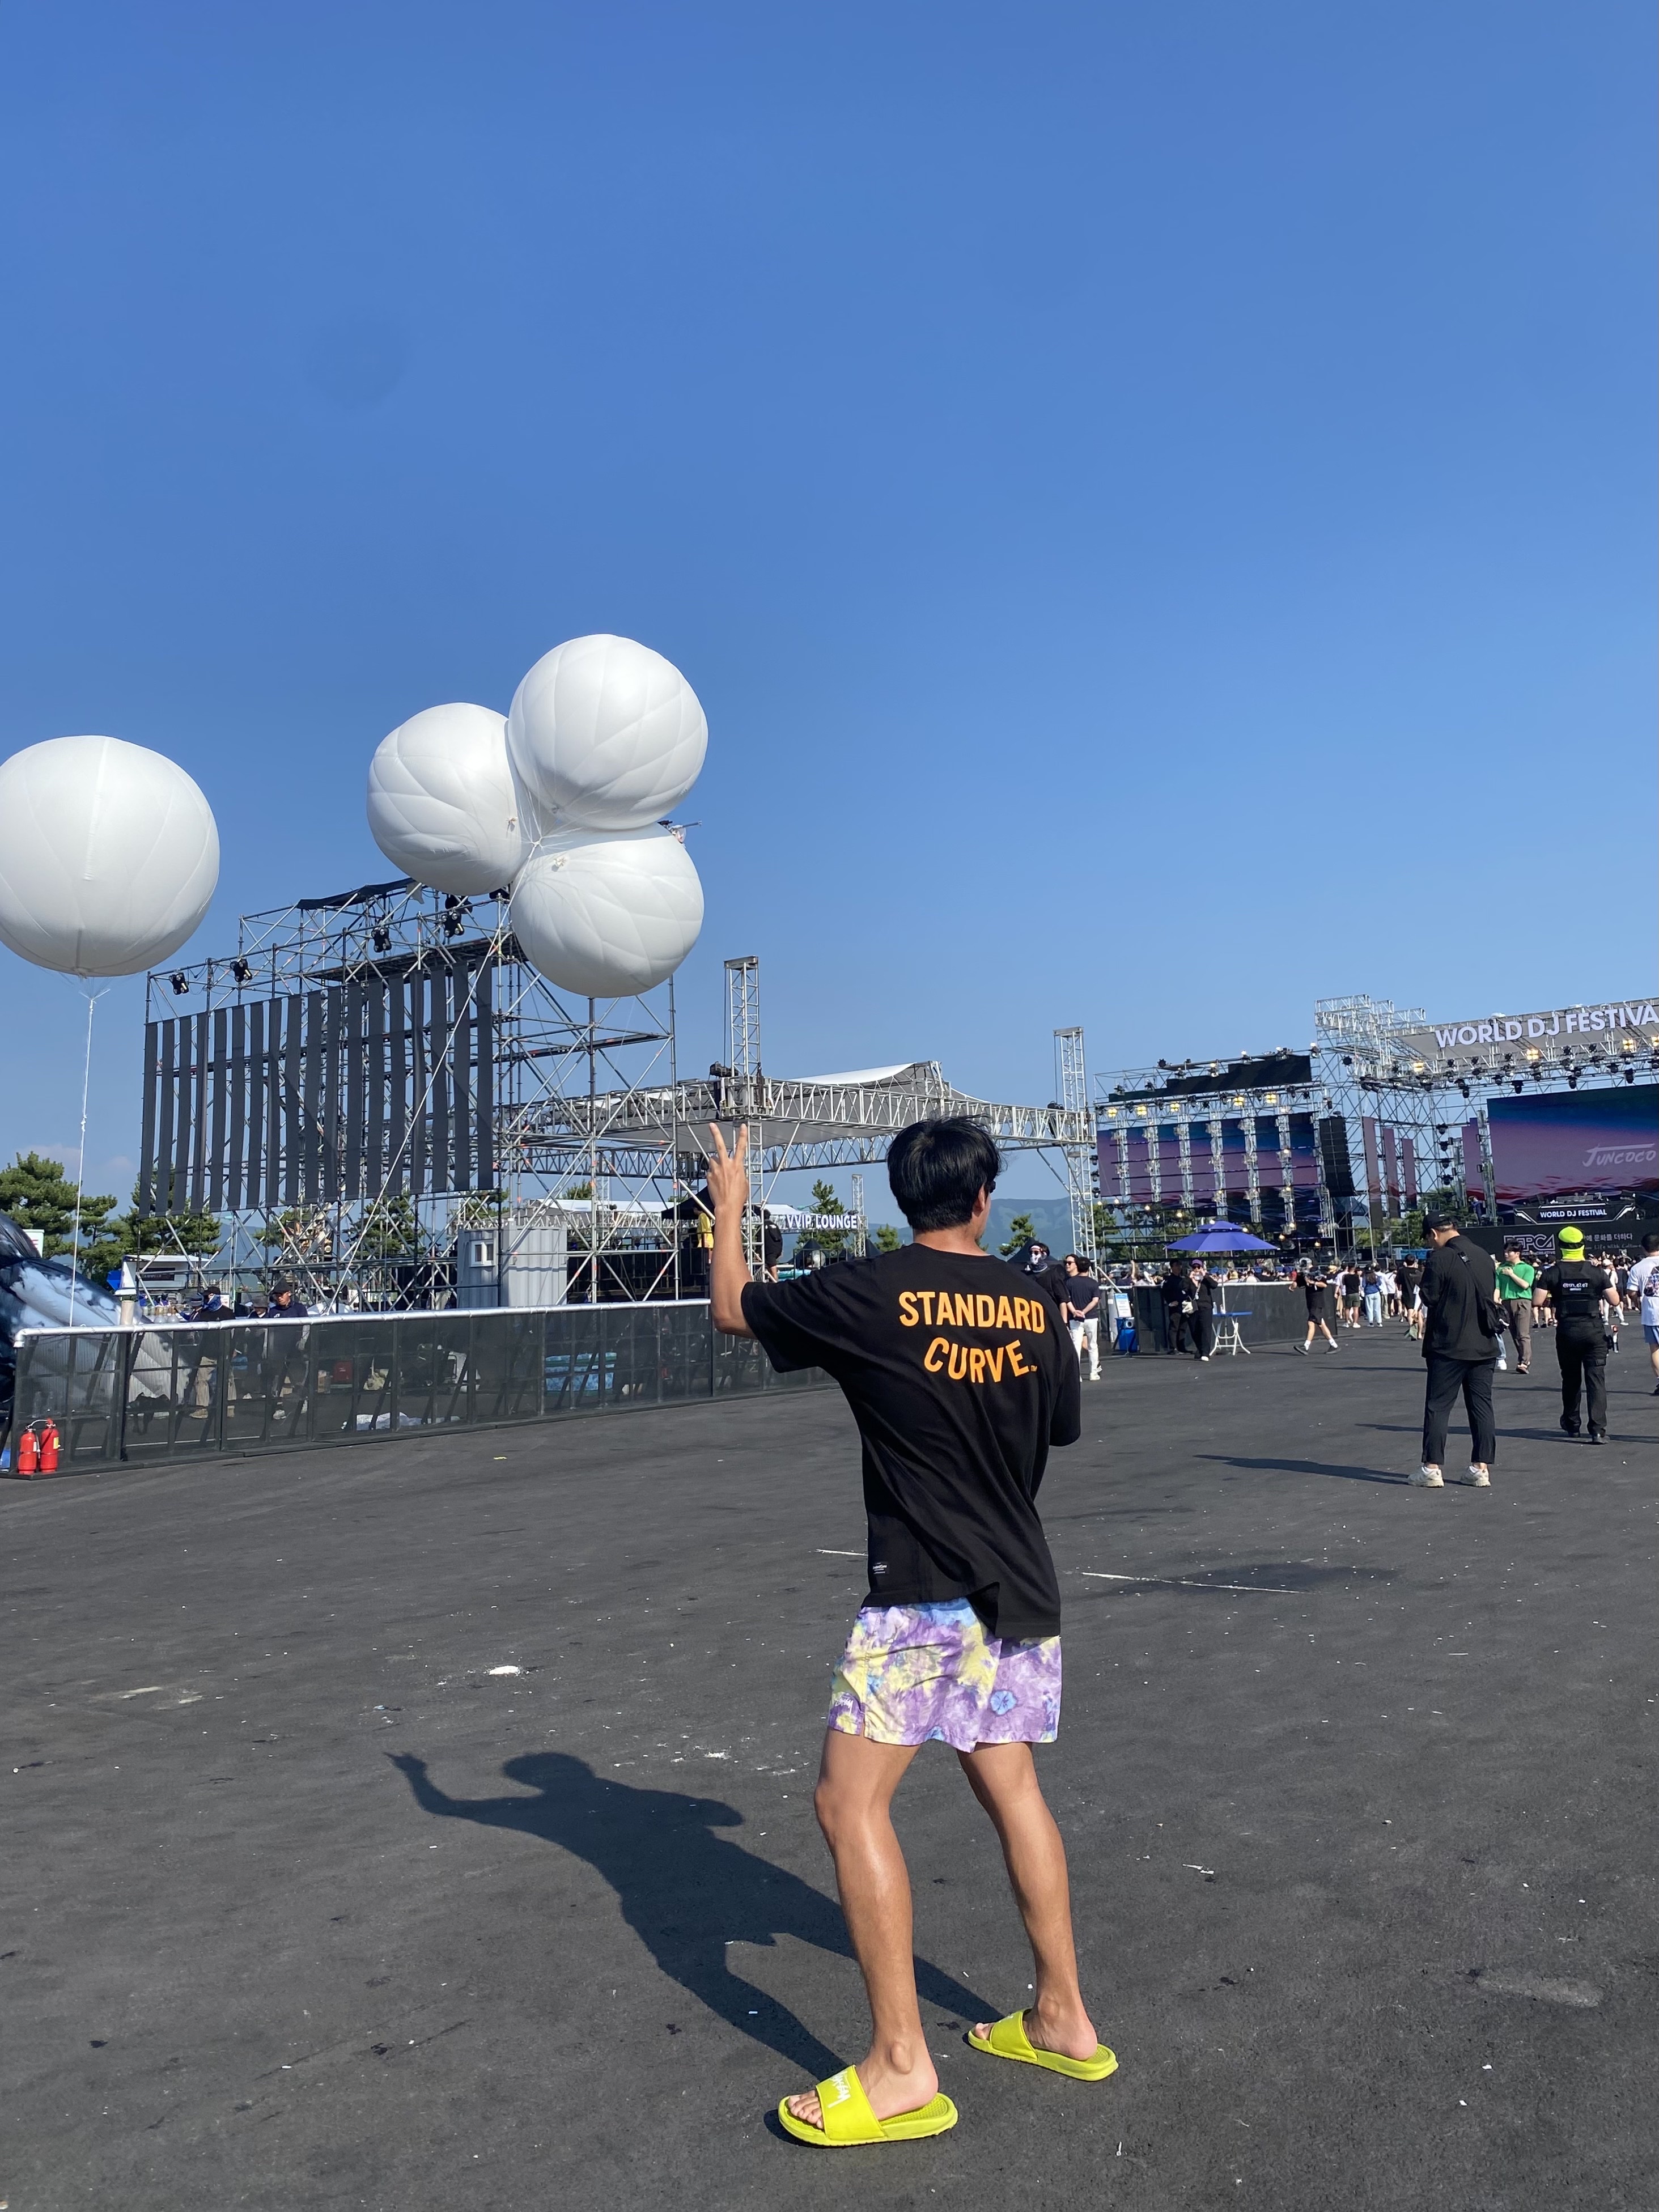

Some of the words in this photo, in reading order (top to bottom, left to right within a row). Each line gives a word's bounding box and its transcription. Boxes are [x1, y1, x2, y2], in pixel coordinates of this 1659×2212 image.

[1435, 1021, 1523, 1048] WORLD
[1527, 1014, 1560, 1038] DJ
[1565, 1004, 1659, 1034] FESTIVA
[1582, 1143, 1656, 1167] JUNCOCO
[786, 1215, 812, 1229] VVIP
[816, 1215, 858, 1229] LOUNGE
[898, 1291, 1045, 1334] STANDARD
[924, 1336, 1029, 1384] CURVE
